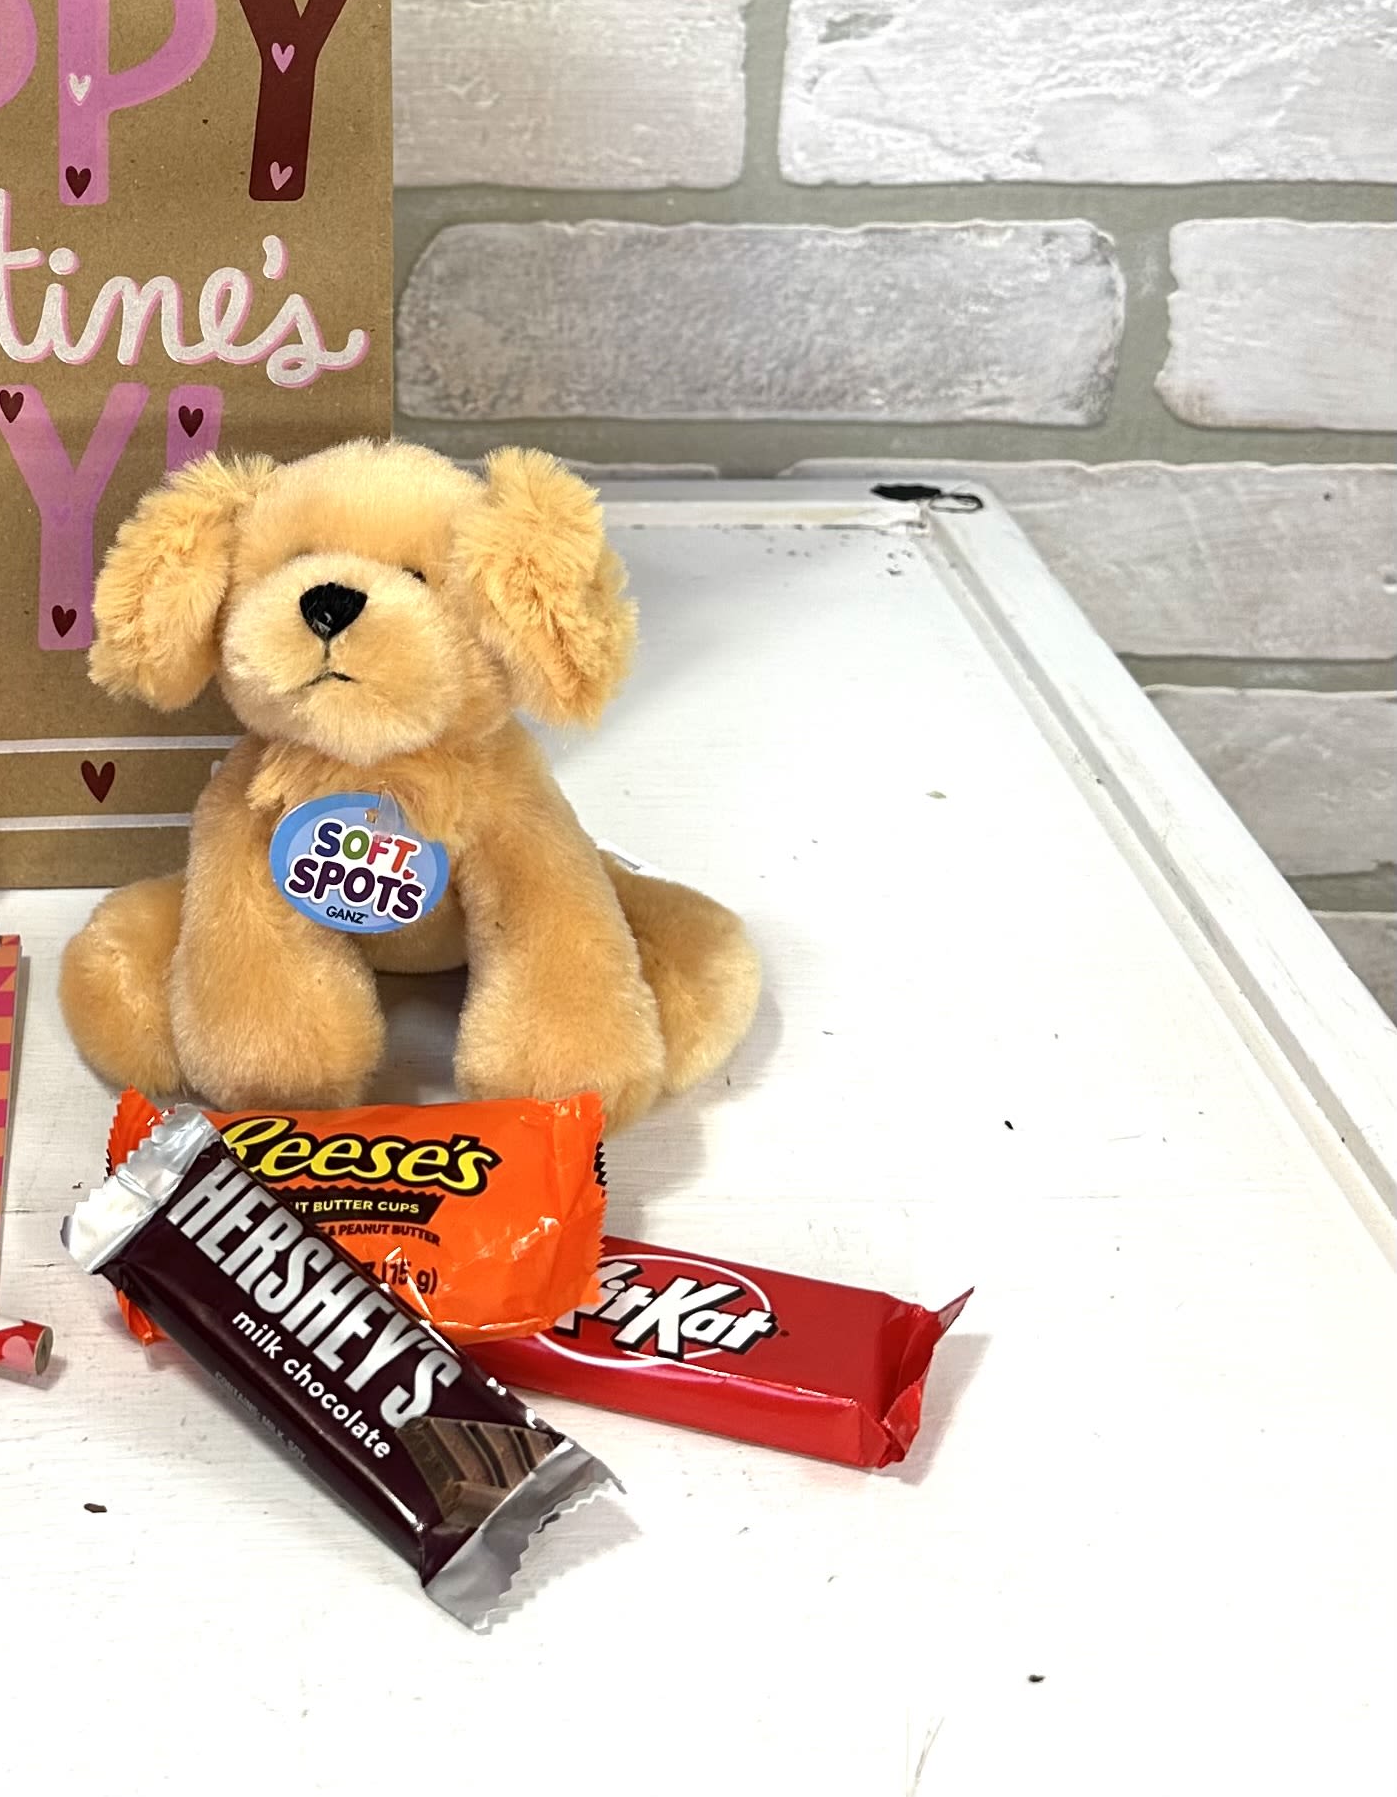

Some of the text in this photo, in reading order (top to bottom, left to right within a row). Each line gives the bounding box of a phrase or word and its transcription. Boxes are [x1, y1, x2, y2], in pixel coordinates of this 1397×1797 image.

[315, 822, 417, 873] SOFT
[289, 858, 422, 919] SPOTS
[326, 906, 365, 924] GANZ
[313, 1199, 372, 1212] BUTTER
[378, 1201, 419, 1213] CUPS
[339, 1223, 390, 1235] PEANUT
[391, 1224, 441, 1246] BUTTER
[167, 1157, 462, 1429] HERSHEY'S
[232, 1310, 391, 1459] milk chocolate
